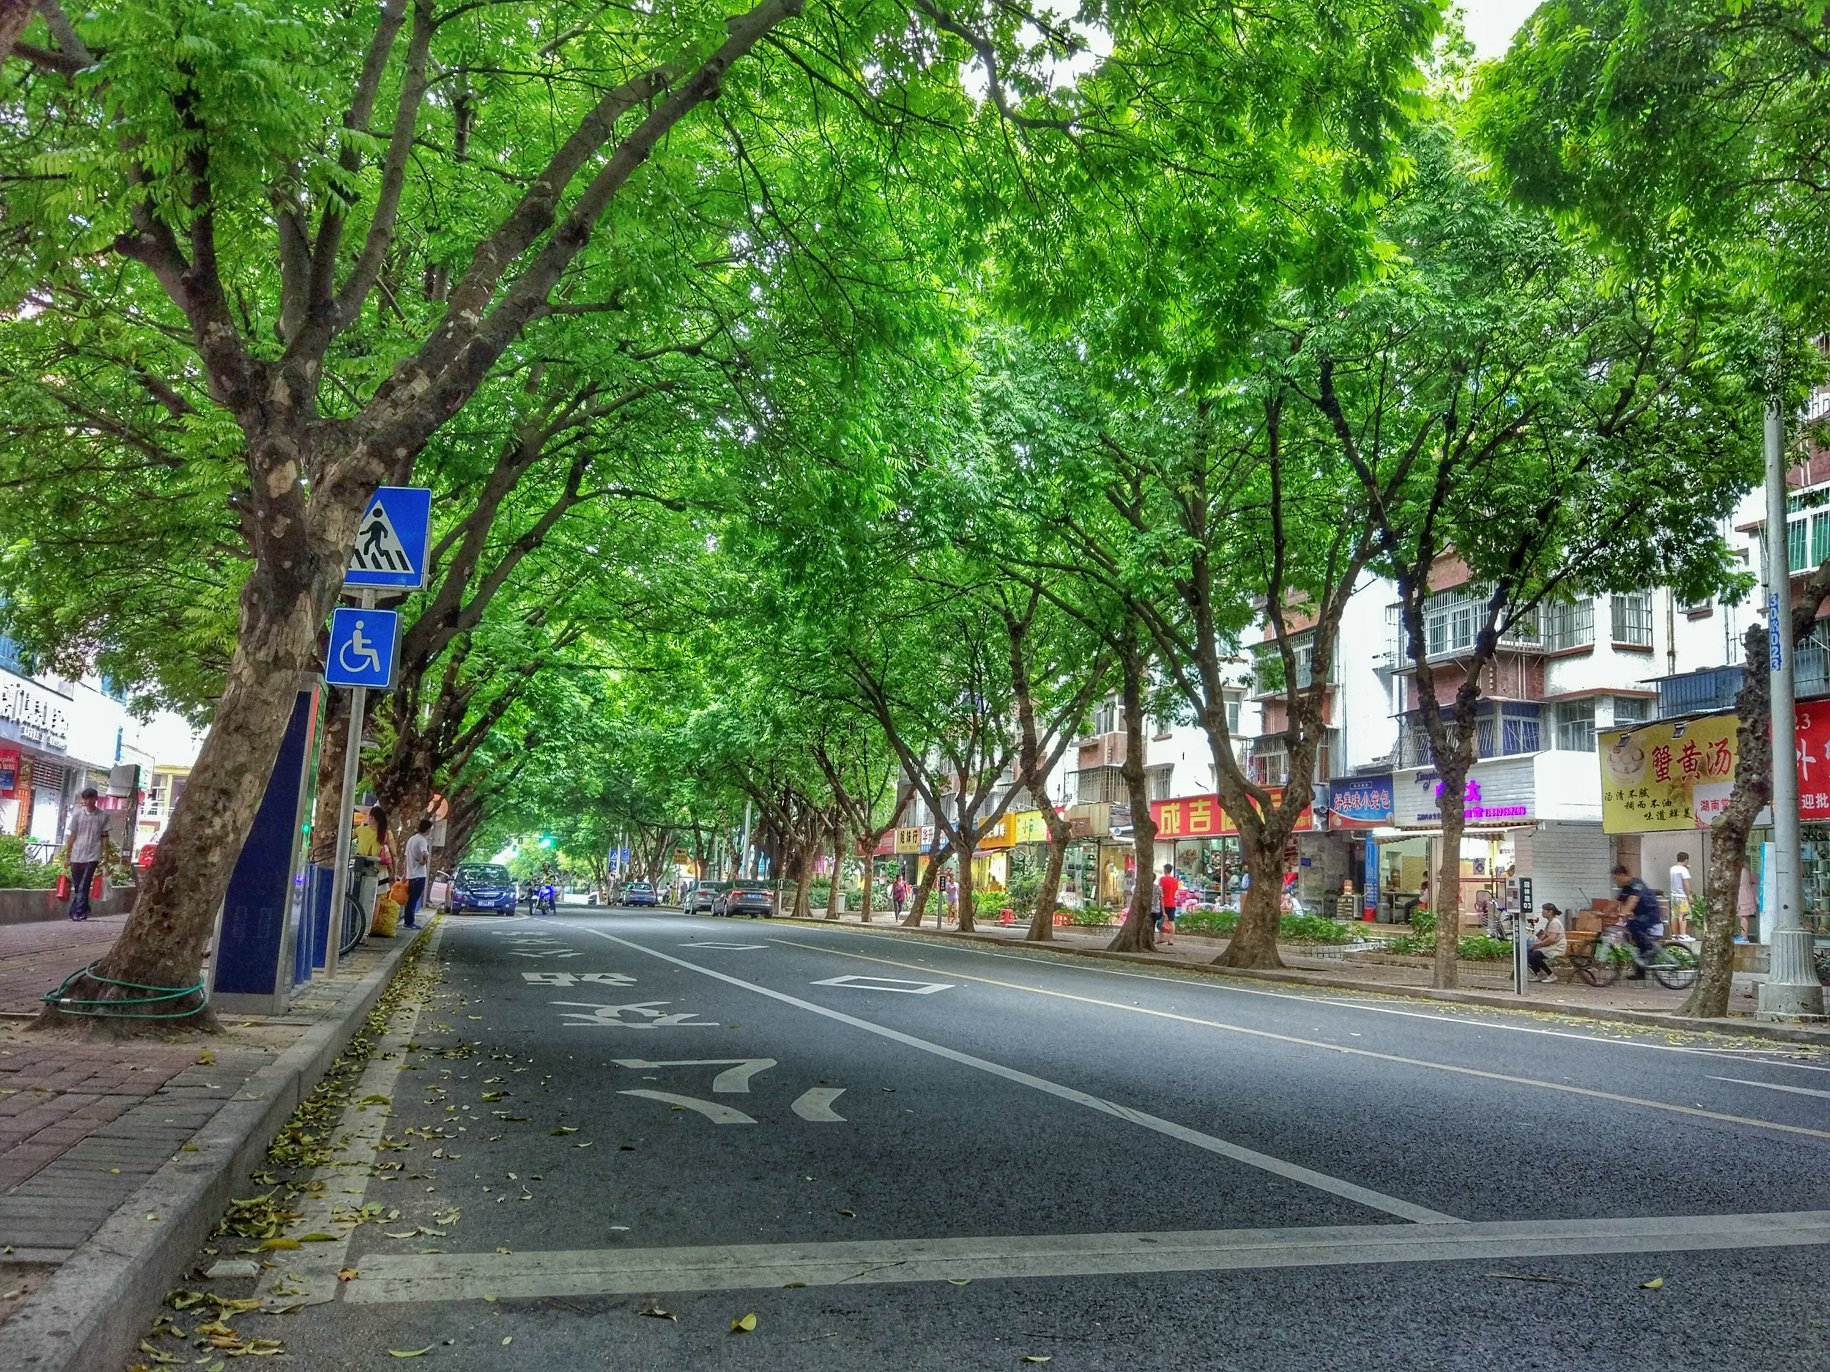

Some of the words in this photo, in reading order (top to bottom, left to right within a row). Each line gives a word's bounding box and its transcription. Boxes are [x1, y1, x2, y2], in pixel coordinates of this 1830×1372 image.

[1651, 737, 1732, 784] 蟹黄汤
[1643, 808, 1694, 821] 味道鲜美
